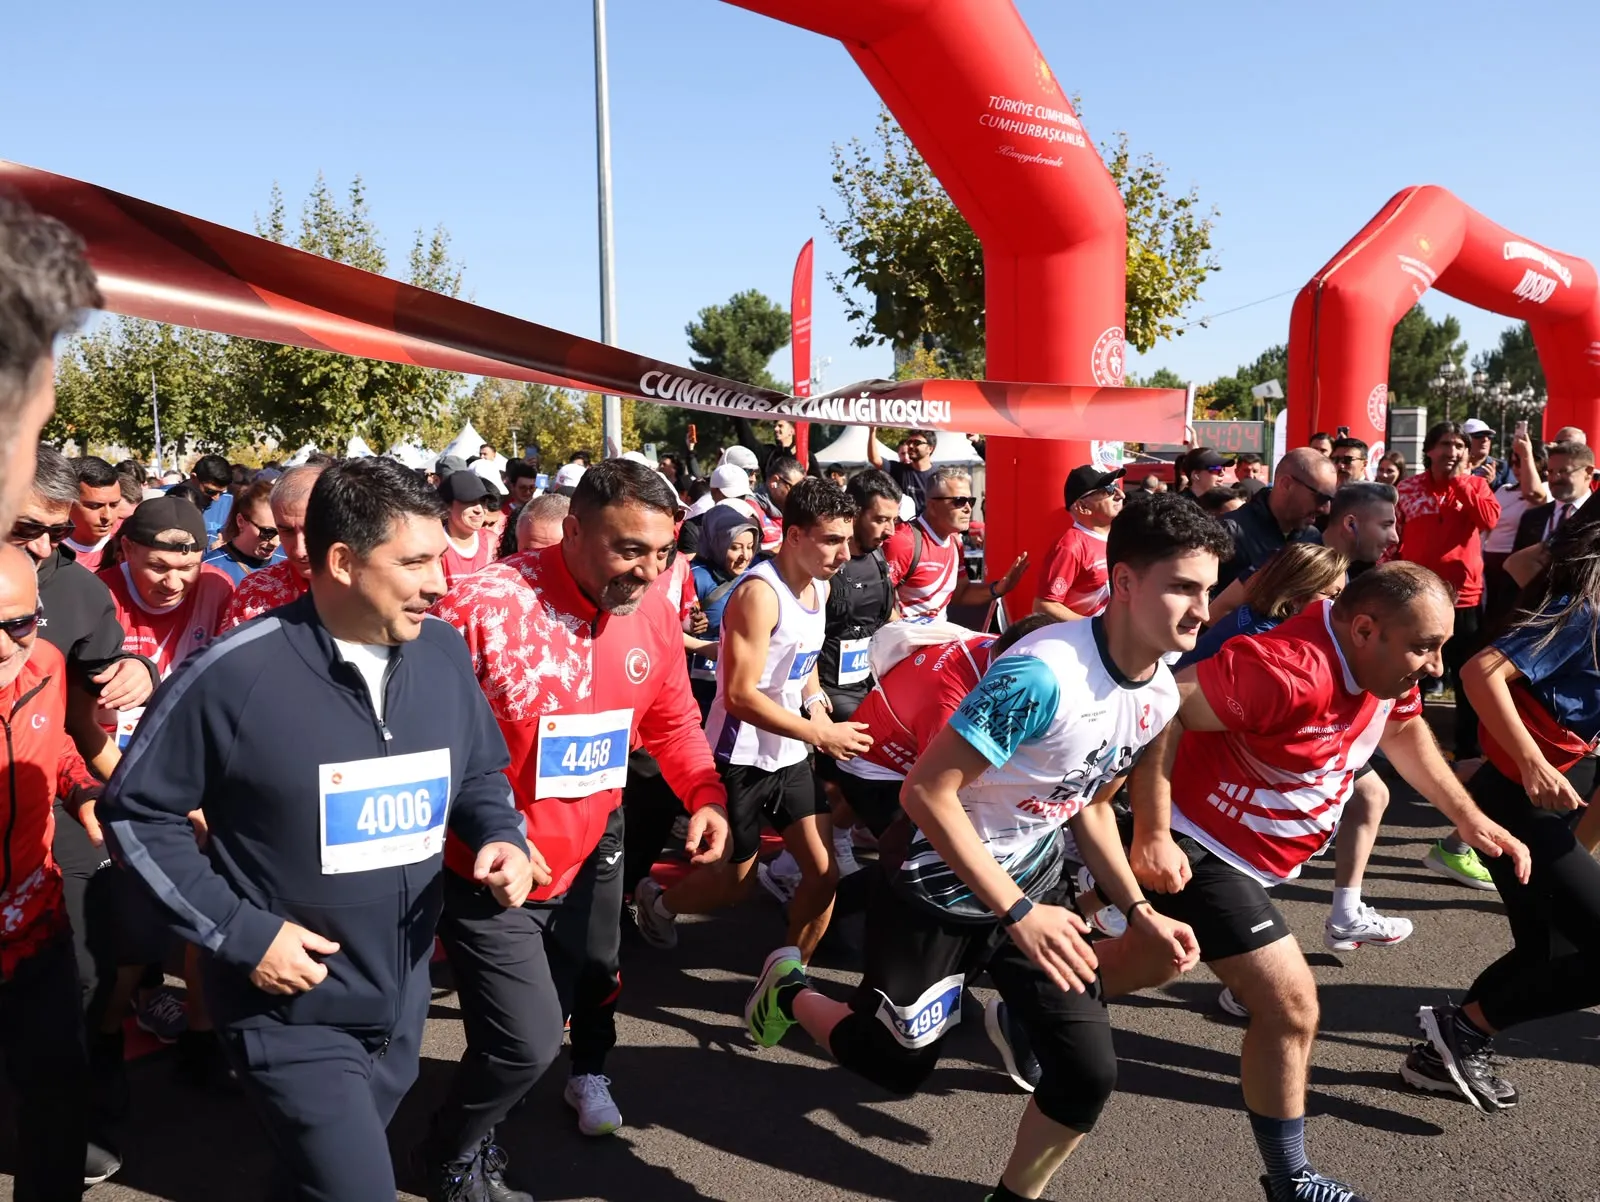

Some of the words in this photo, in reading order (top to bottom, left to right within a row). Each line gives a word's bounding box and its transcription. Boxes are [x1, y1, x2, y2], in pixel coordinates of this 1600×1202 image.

[988, 95, 1034, 117] TÜRKİYE
[880, 398, 951, 428] KOŞUSU
[561, 738, 612, 772] 4458
[356, 788, 432, 836] 4006
